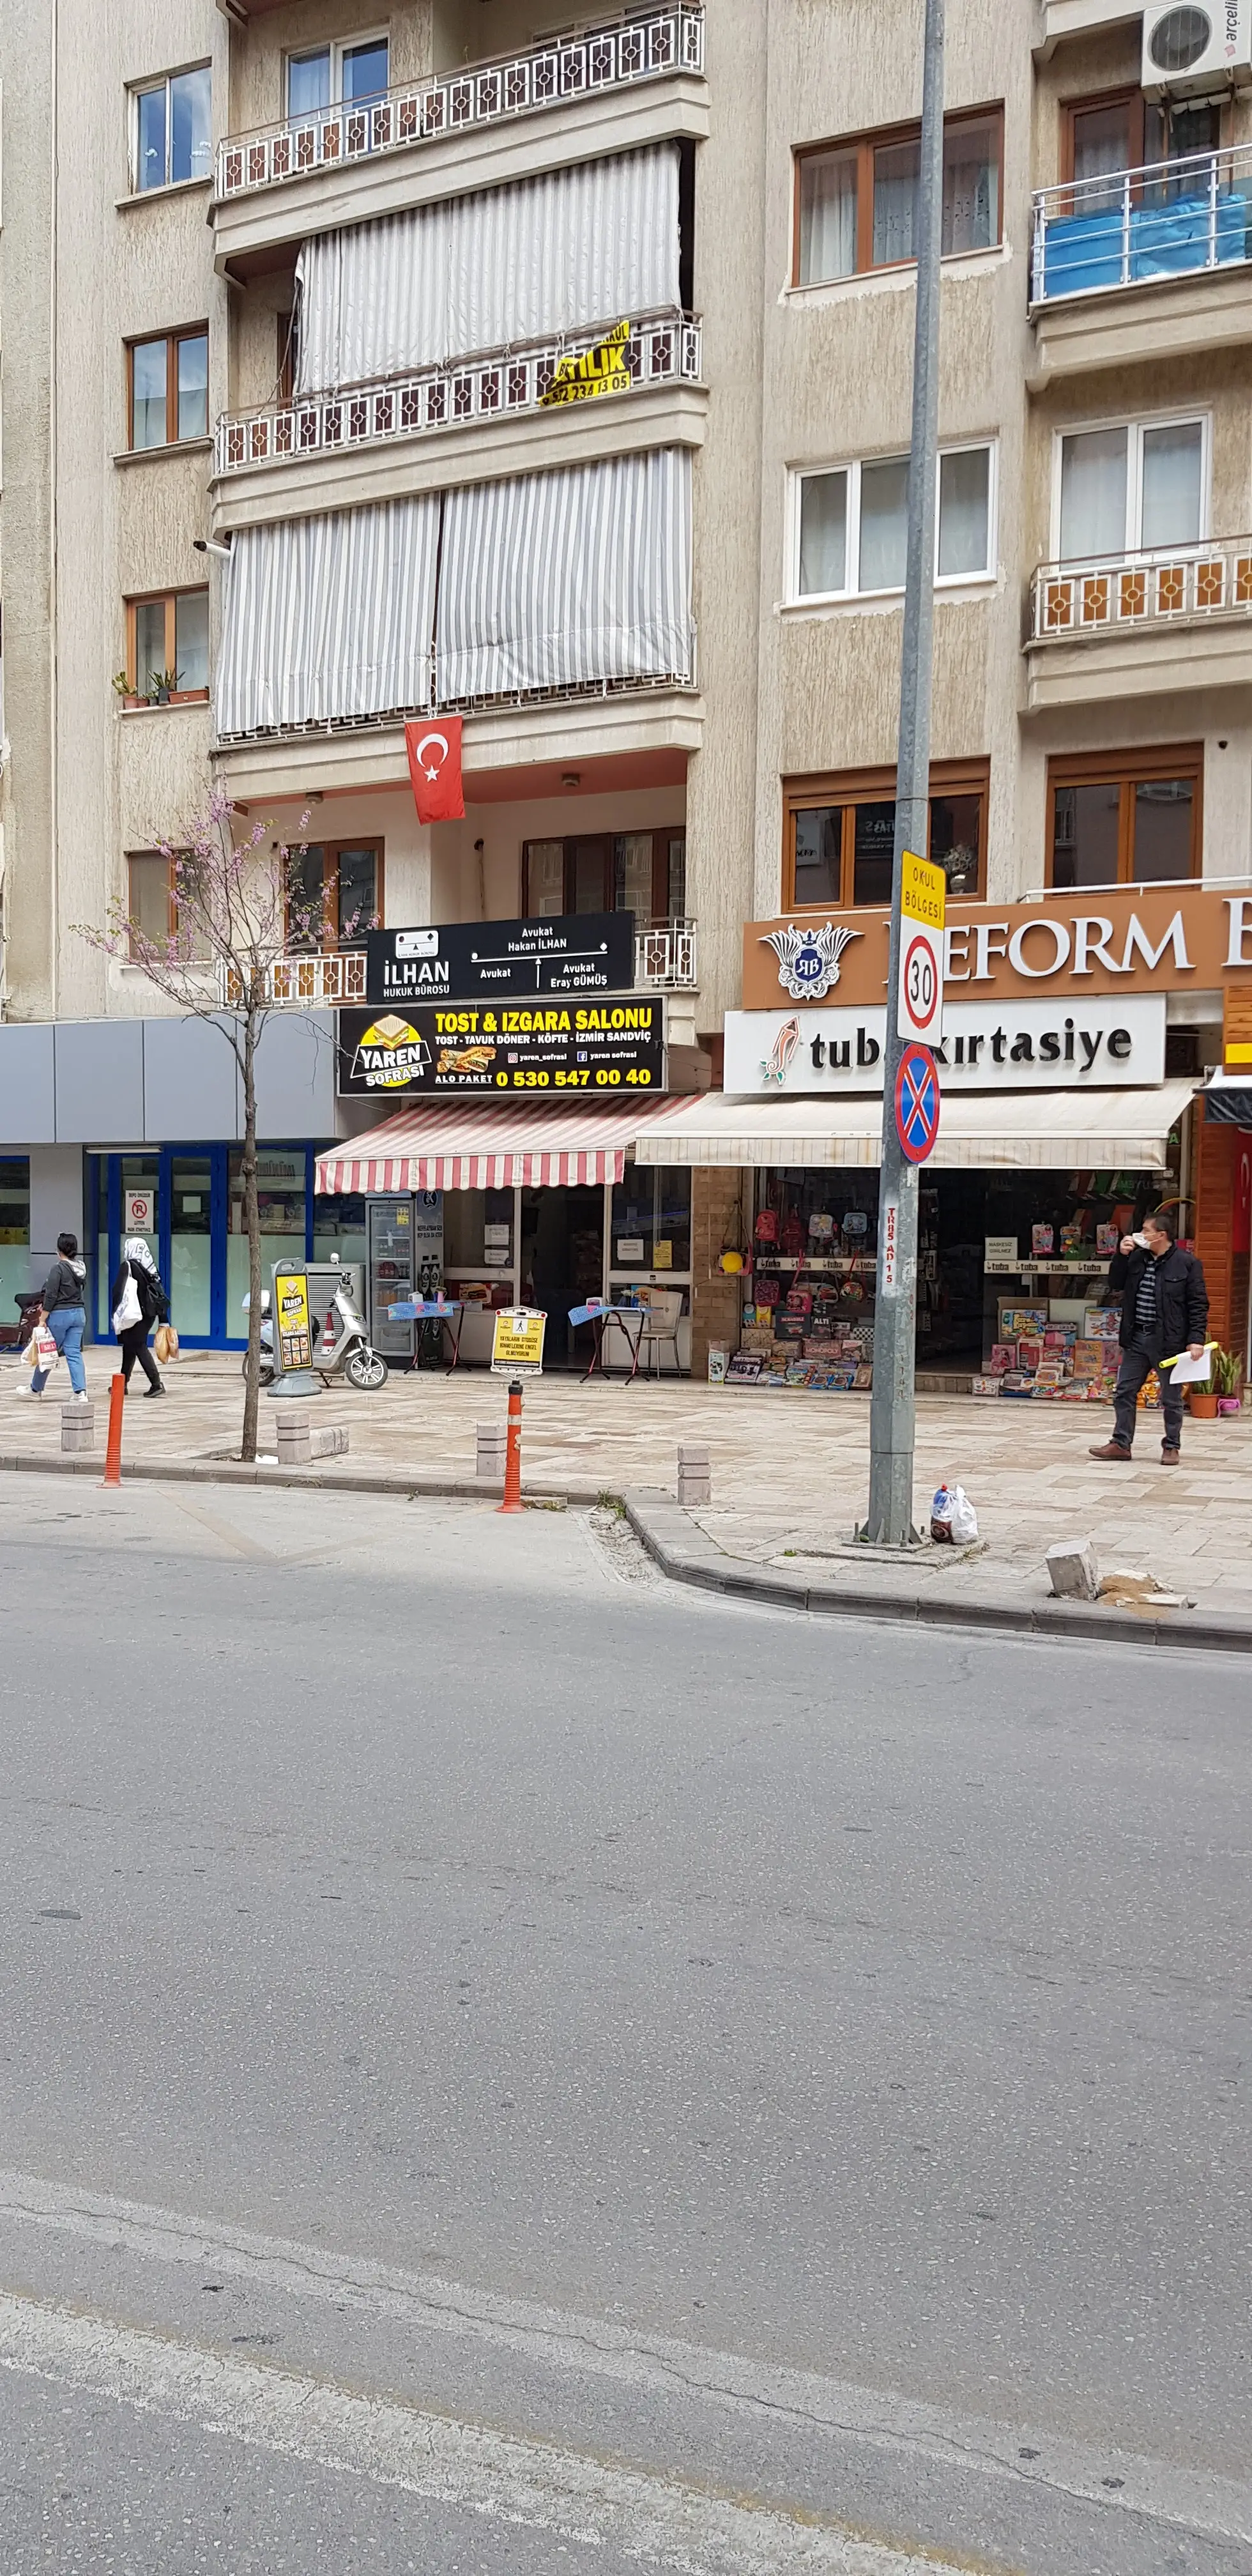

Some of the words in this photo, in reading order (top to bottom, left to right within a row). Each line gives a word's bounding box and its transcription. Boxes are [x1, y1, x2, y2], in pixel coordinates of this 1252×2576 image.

[1225, 0, 1241, 41] arçeli
[612, 375, 627, 390] 05
[913, 867, 936, 891] OKUL
[905, 891, 942, 921] BÖLGESİ
[521, 927, 553, 937] Avukat
[508, 942, 536, 952] Hakan
[538, 939, 567, 949] İLHAN
[882, 910, 1197, 985] EFORM
[384, 960, 450, 985] İLHAN
[480, 968, 511, 979] Avukat
[563, 963, 595, 974] Avukat
[551, 977, 571, 988] Eray
[573, 973, 607, 986] GÜMÜŞ
[910, 960, 932, 1006] 30
[383, 988, 413, 997] HUKUK
[415, 985, 450, 995] BÜROSU
[435, 1013, 479, 1032] TOST
[483, 1012, 497, 1032] &
[502, 1011, 571, 1031] IZGARA
[575, 1008, 652, 1031] SALONU
[436, 1036, 459, 1045] TOST
[465, 1035, 495, 1045] TAVUK
[496, 1033, 530, 1044] DÖNER
[538, 1033, 568, 1043] KÖFTE
[576, 1031, 604, 1043] İZMİR
[606, 1029, 652, 1043] SANDVİÇ
[360, 1045, 421, 1069] YAREN
[810, 1027, 880, 1069] tub
[365, 1064, 425, 1087] SOFRASI
[435, 1075, 455, 1083] ALO
[459, 1075, 492, 1083] PAKET
[496, 1071, 508, 1087] 0
[513, 1071, 549, 1086] 530
[554, 1070, 590, 1085] 547
[595, 1069, 620, 1085] 00
[625, 1068, 651, 1084] 40
[283, 1296, 302, 1309] YAREN
